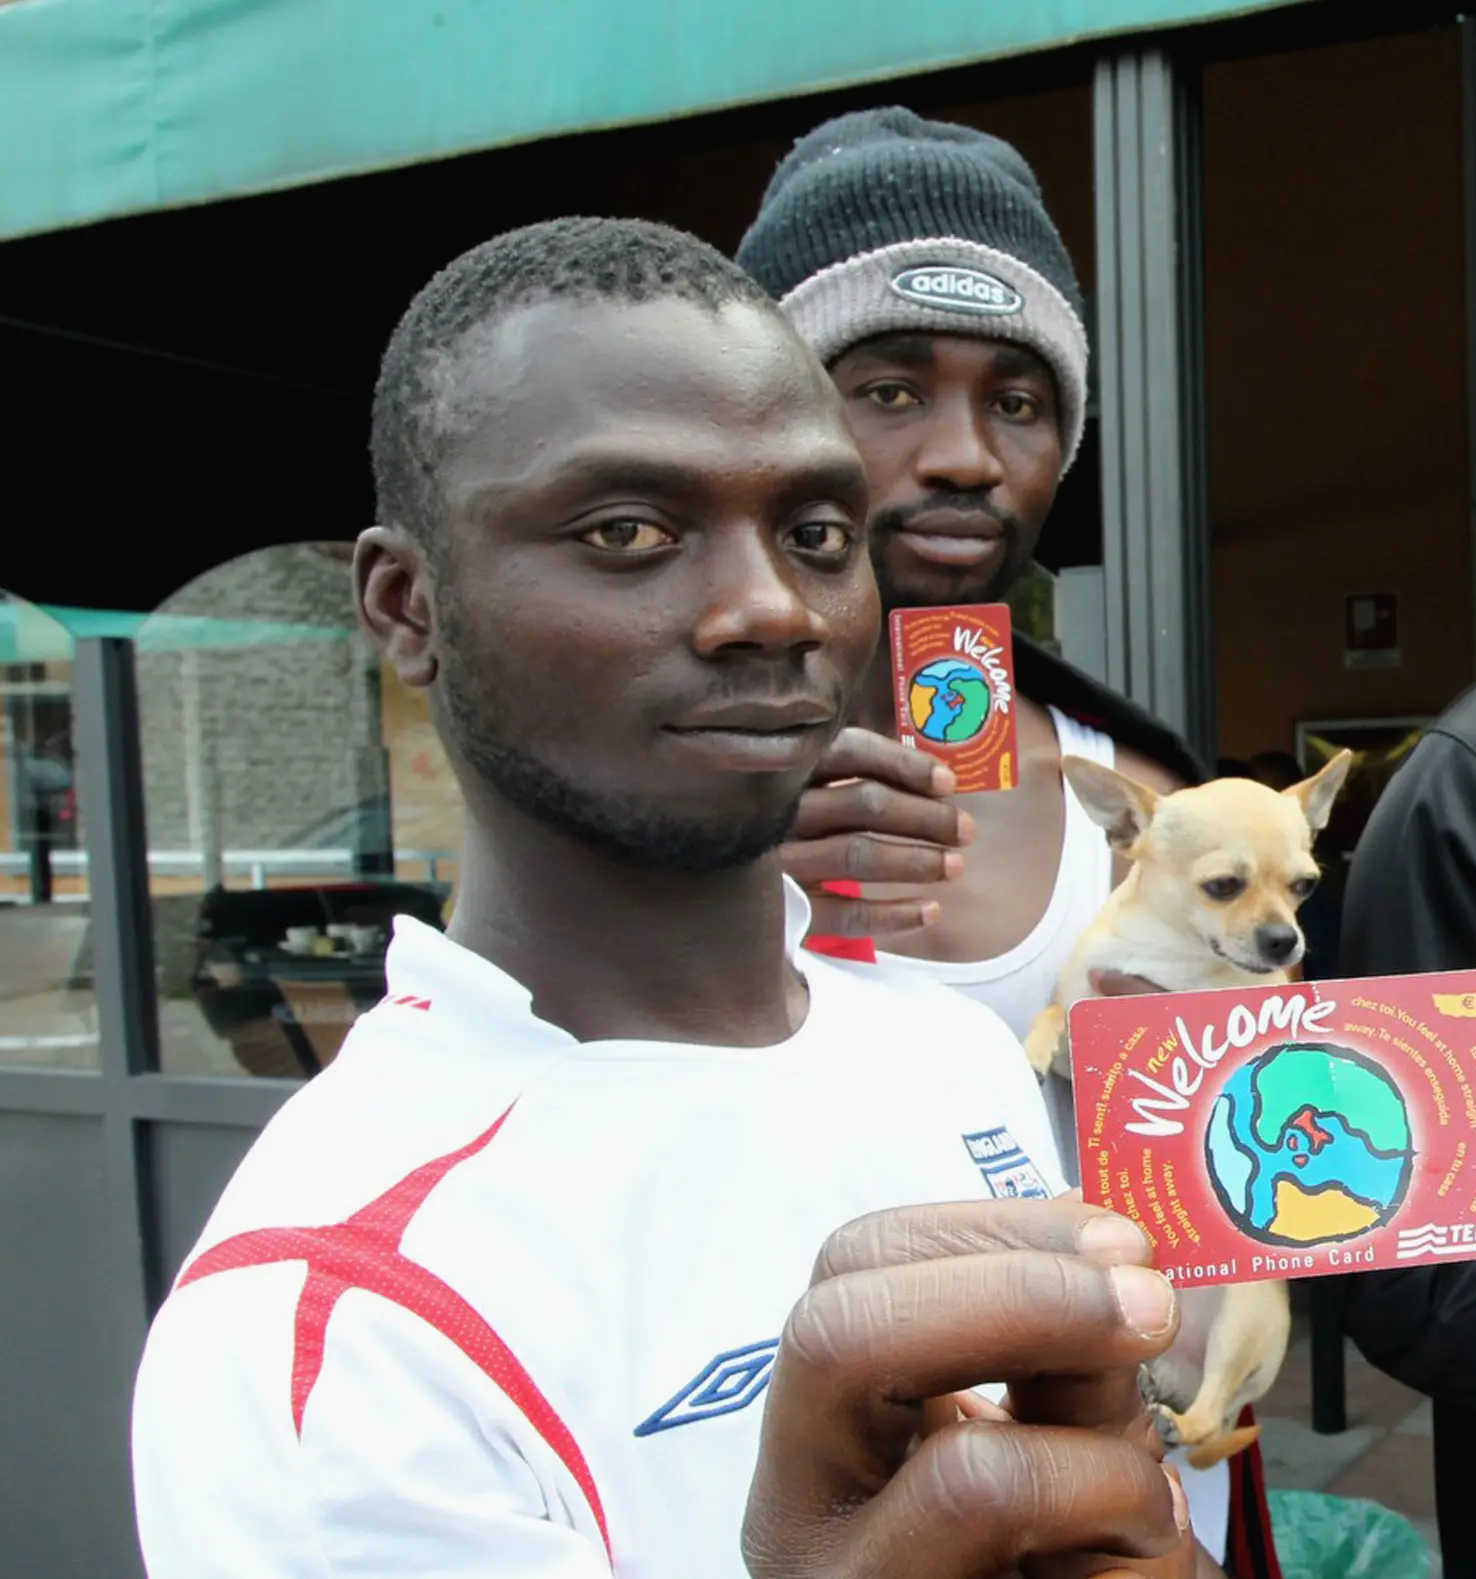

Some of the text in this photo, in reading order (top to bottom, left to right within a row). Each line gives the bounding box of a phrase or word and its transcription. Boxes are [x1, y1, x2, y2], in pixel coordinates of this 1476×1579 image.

[911, 273, 1004, 303] adidas
[953, 625, 1012, 715] Welcome
[1146, 1027, 1179, 1074] new
[1351, 996, 1378, 1011] chez
[1416, 1022, 1439, 1043] feel
[1435, 1039, 1448, 1053] at
[1443, 1049, 1466, 1082] home
[1124, 994, 1337, 1137] Welcome
[1378, 1027, 1392, 1042] Te
[1392, 1037, 1427, 1068] sientes
[1424, 1067, 1450, 1126] enseguida
[1093, 1102, 1108, 1135] senti
[1096, 1149, 1109, 1166] de
[1455, 1142, 1467, 1158] en
[1099, 1168, 1111, 1195] tout
[1142, 1148, 1180, 1250] You feel at home
[1162, 1160, 1201, 1244] straight away.
[1123, 1189, 1141, 1220] chez
[1165, 1246, 1376, 1282] ational Phone Card
